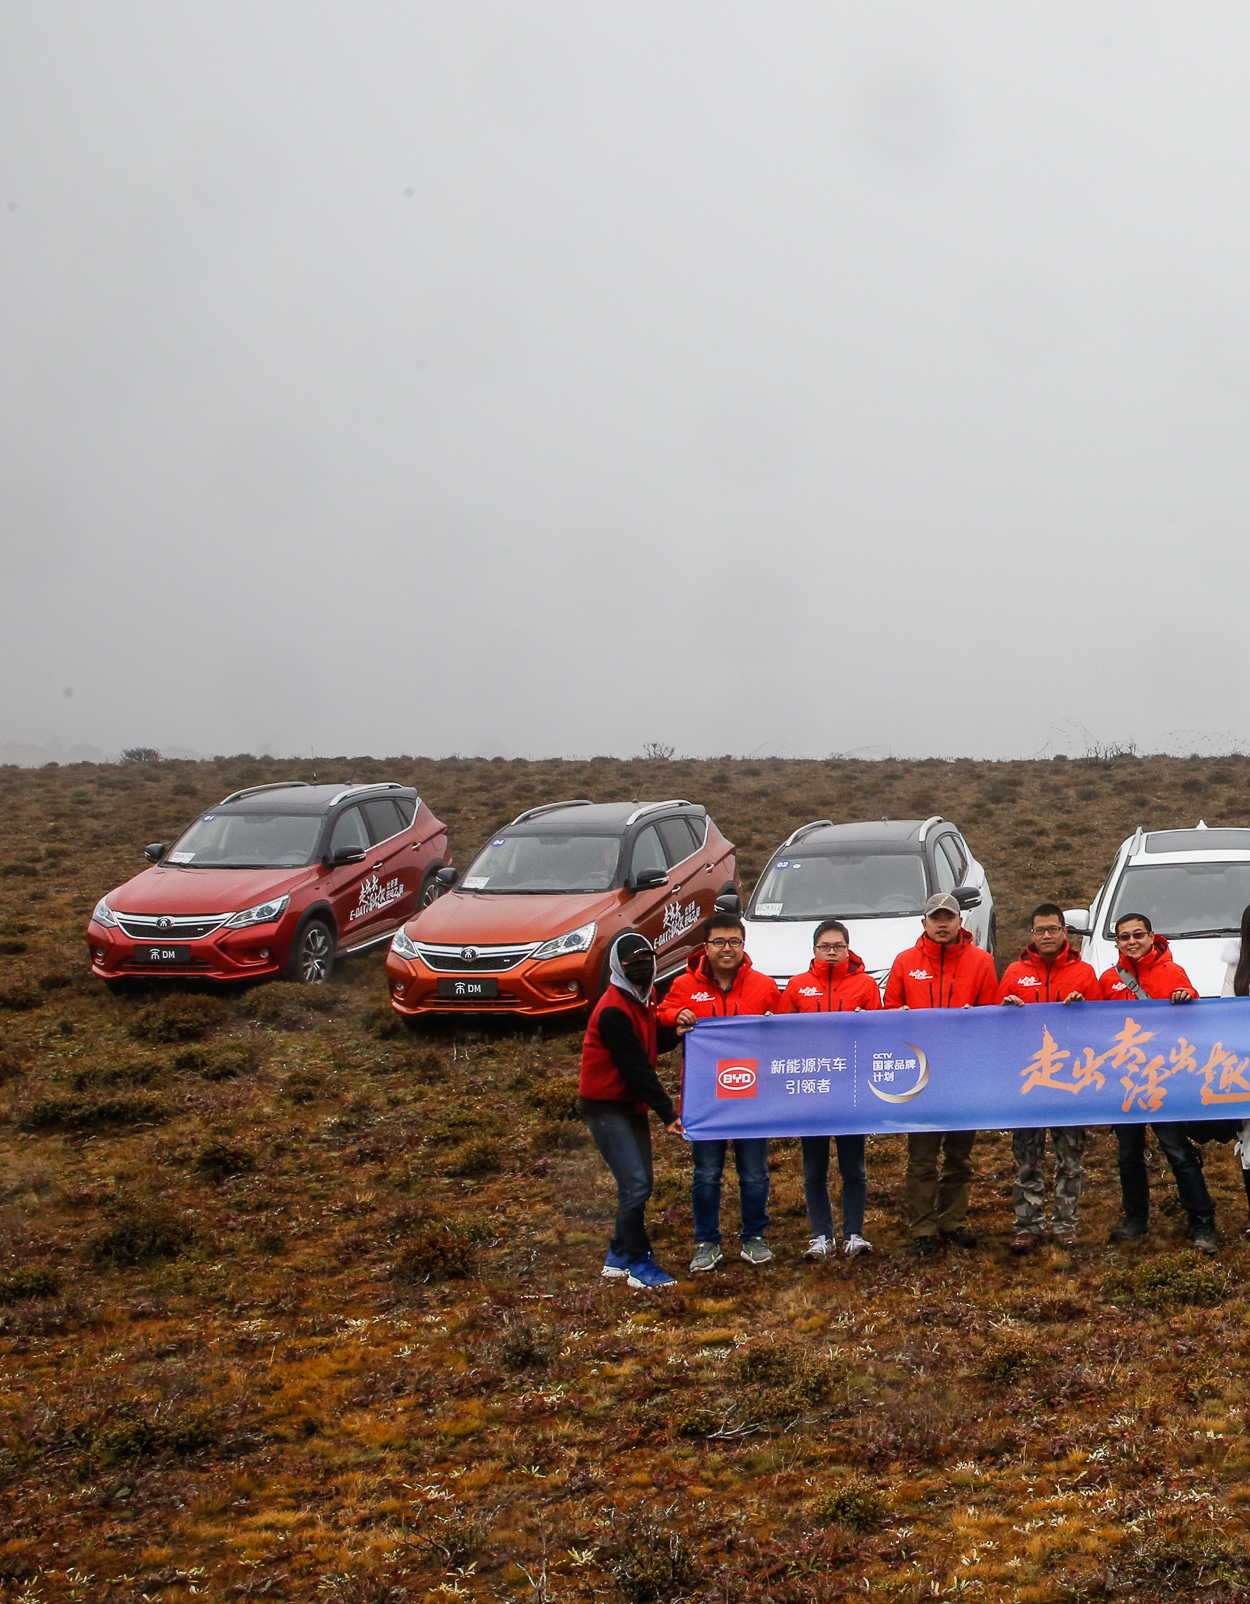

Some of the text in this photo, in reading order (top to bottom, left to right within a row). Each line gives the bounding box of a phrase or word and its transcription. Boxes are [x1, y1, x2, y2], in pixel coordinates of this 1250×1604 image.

[162, 950, 175, 959] DM
[467, 984, 482, 993] DM
[770, 1057, 847, 1075] 新能源汽车
[872, 1059, 917, 1071] 国家品牌
[723, 1073, 751, 1084] BYD
[872, 1071, 895, 1082] 计划
[785, 1079, 832, 1095] 引领者
